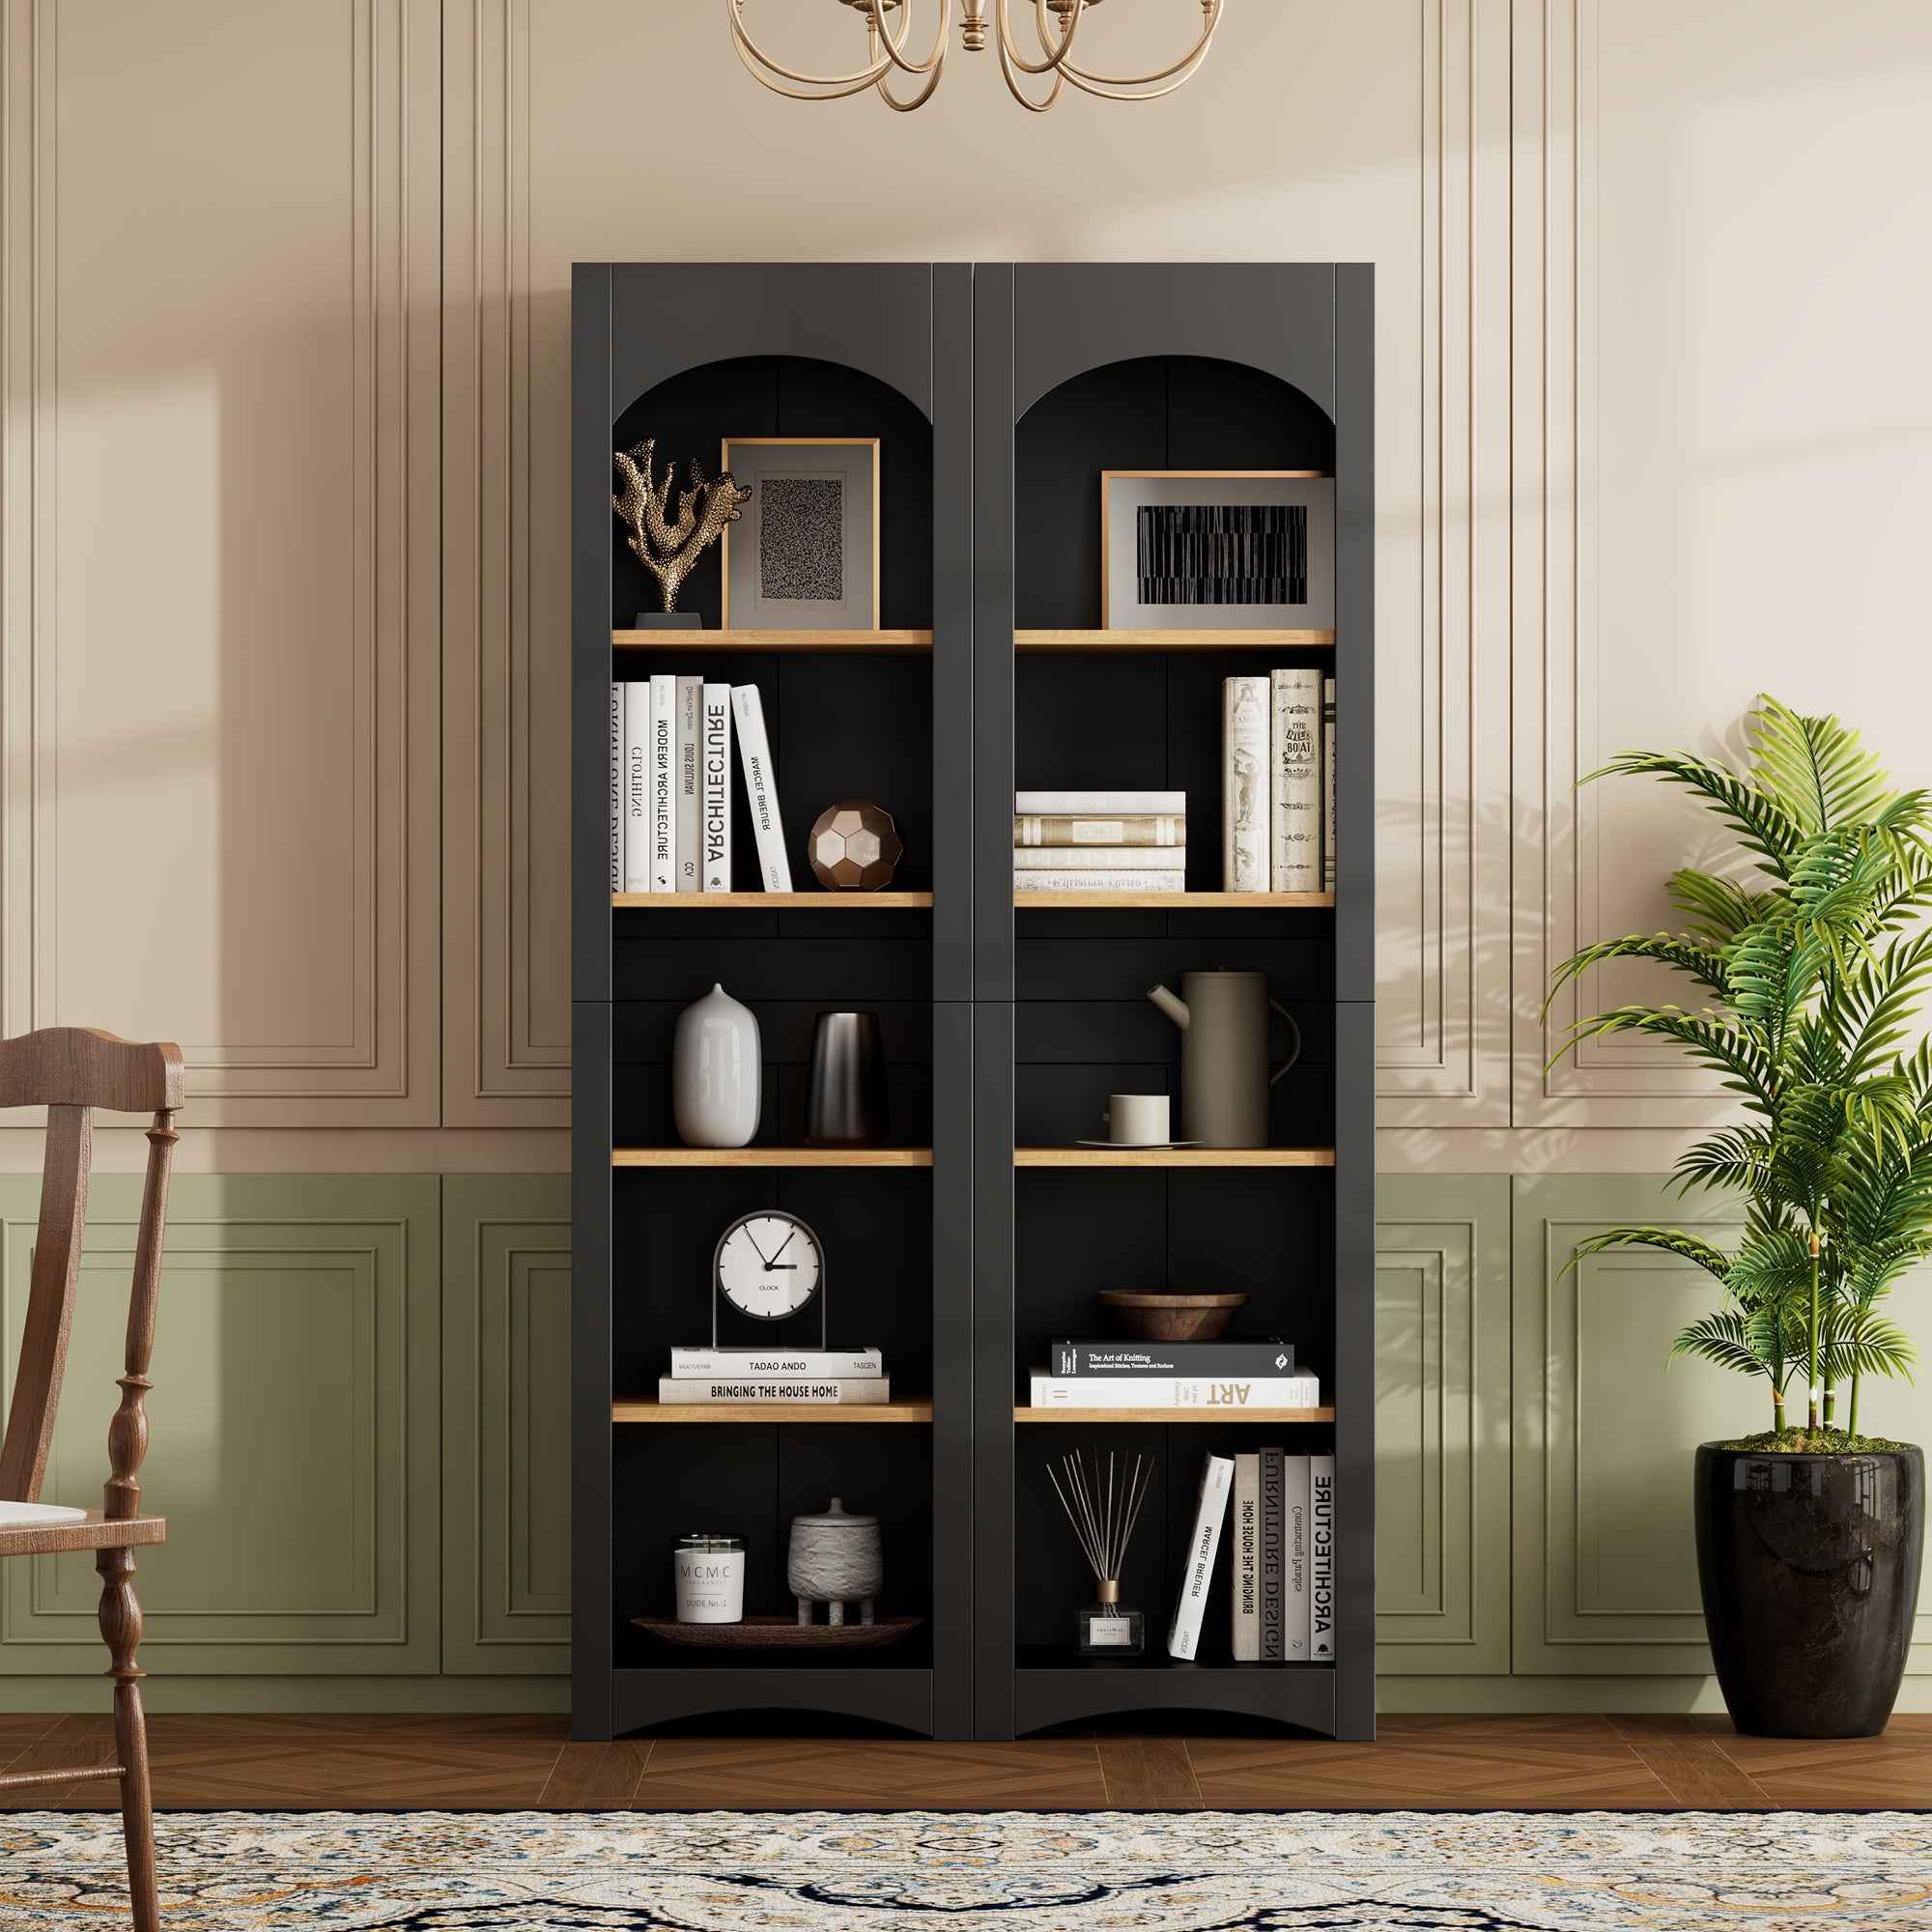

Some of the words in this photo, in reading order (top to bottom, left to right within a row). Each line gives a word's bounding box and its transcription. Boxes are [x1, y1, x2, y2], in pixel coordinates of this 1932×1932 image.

[1287, 742, 1311, 753] BOAT
[1088, 1353, 1102, 1362] The
[1103, 1353, 1115, 1362] Art
[1115, 1353, 1122, 1362] of
[1122, 1353, 1151, 1364] Knitting
[750, 1362, 779, 1372] TADAO
[781, 1362, 807, 1372] ANDO
[711, 1385, 755, 1398] BRINGING
[757, 1385, 777, 1398] THE
[779, 1385, 810, 1398] HOUSE
[811, 1385, 838, 1398] HOME
[1206, 1383, 1252, 1406] ART
